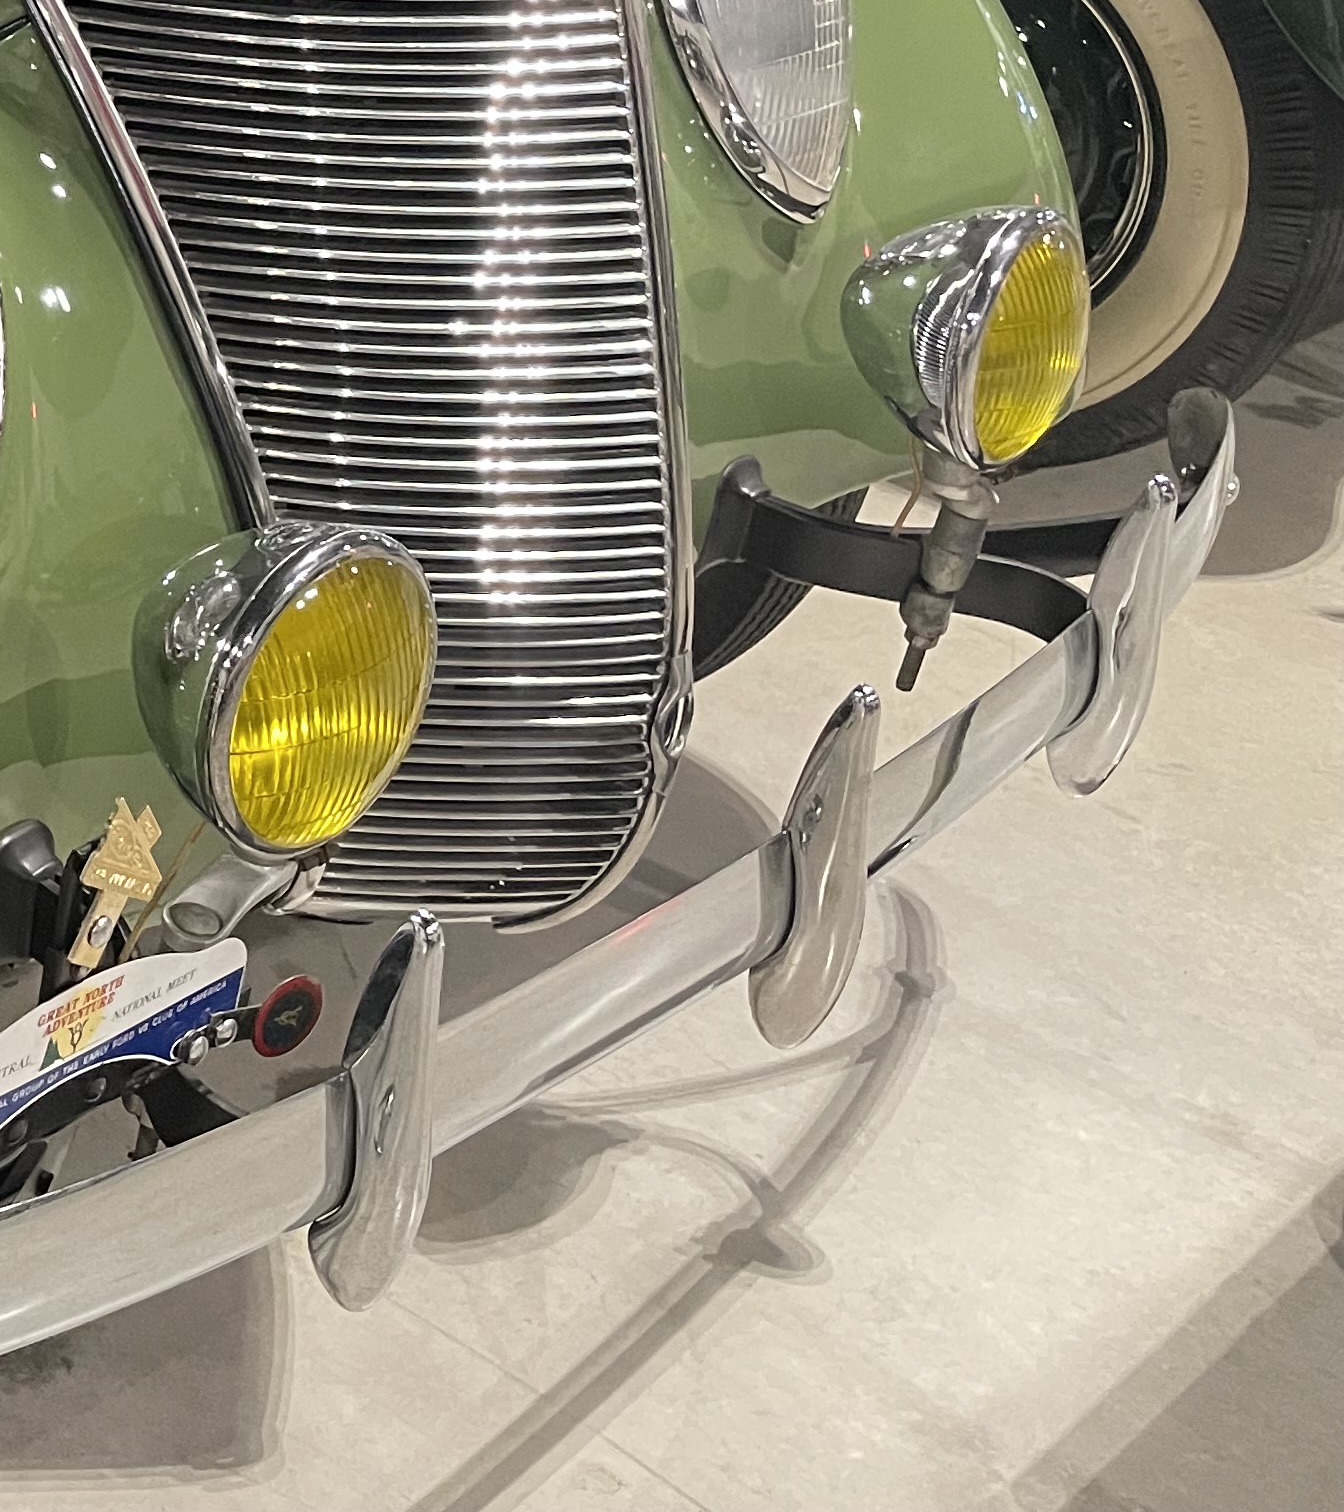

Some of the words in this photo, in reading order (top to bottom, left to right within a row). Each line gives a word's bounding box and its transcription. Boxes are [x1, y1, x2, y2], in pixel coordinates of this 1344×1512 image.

[37, 997, 80, 1027] GREAT
[83, 975, 125, 1005] NORTH
[42, 992, 115, 1038] ADVENTURE
[111, 986, 163, 1022] NATIONAL
[166, 968, 198, 993] MEET
[12, 1079, 45, 1102] GROUP
[47, 1070, 60, 1085] OF
[63, 1059, 80, 1076] THE
[83, 1042, 111, 1065] EARLY
[112, 1030, 136, 1050] FORD
[152, 1008, 174, 1027] CLUB
[176, 999, 189, 1013] OF
[189, 979, 227, 1006] AMERICA
